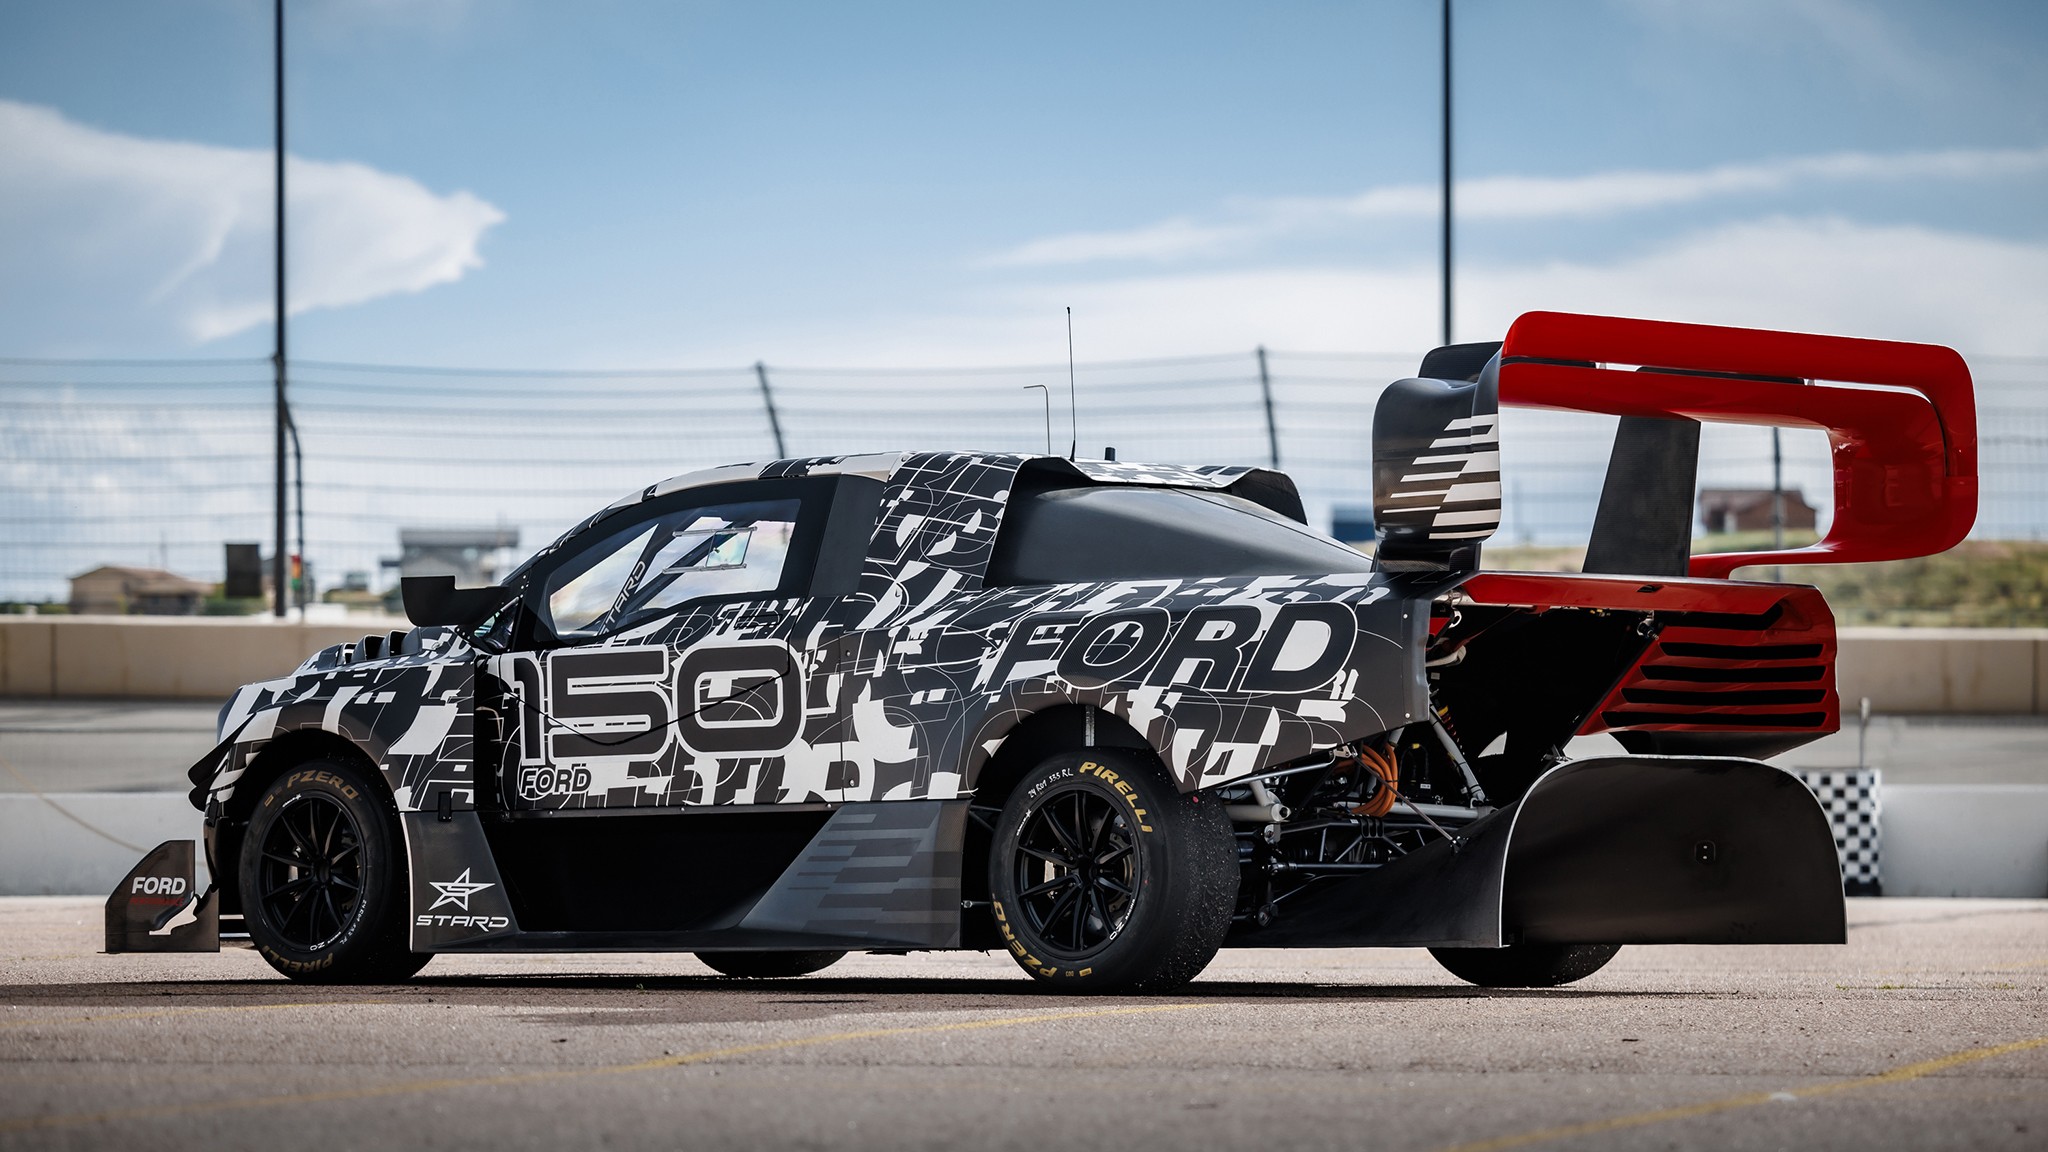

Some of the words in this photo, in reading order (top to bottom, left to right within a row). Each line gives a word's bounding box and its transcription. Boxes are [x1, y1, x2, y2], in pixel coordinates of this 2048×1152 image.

[981, 601, 1358, 695] FORD
[508, 638, 807, 766] 150
[521, 767, 592, 796] FORD
[1079, 761, 1153, 833] PIRELLI
[131, 876, 186, 895] FORD
[416, 914, 509, 932] STARD
[261, 945, 334, 972] PIRELLI
